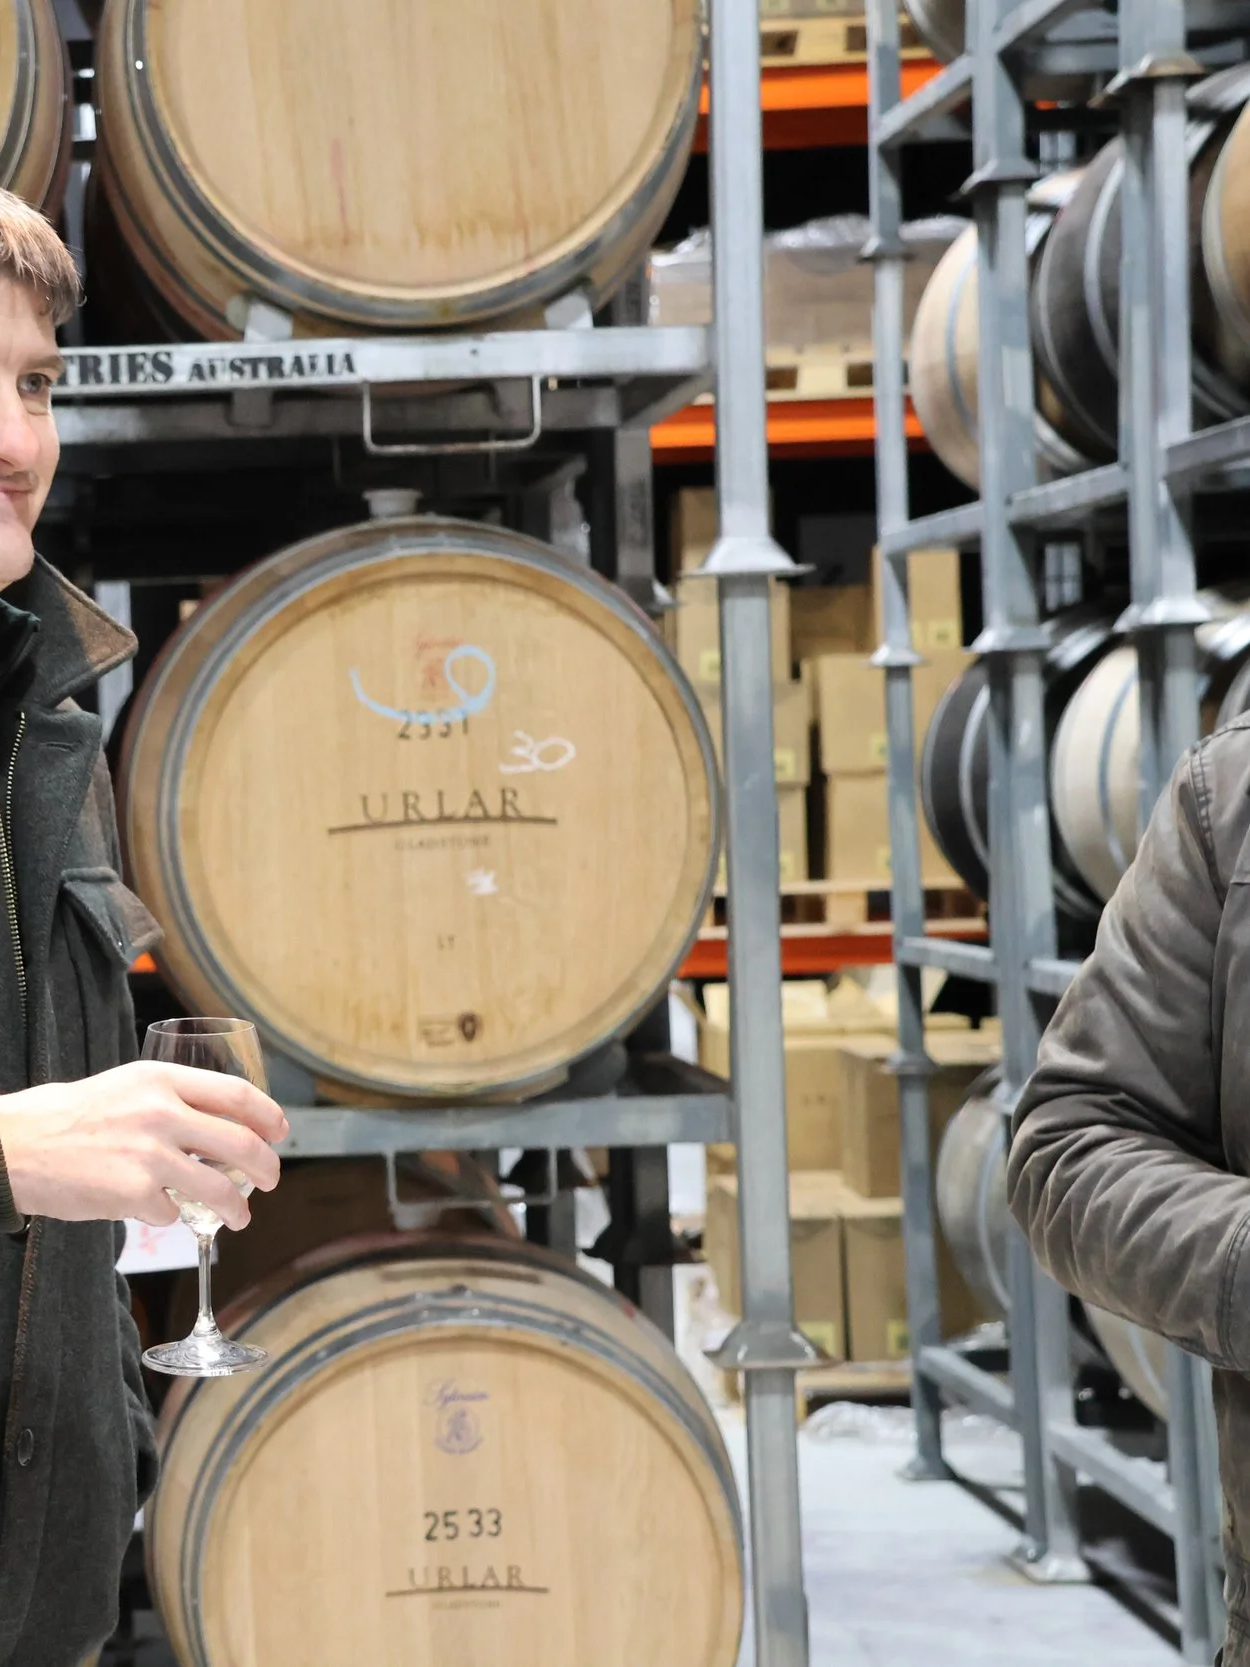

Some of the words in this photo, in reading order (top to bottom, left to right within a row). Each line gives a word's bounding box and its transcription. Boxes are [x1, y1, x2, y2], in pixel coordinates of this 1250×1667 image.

[188, 352, 357, 382] AUSTRALIA
[499, 730, 577, 775] 30
[360, 787, 524, 823] URLAR
[423, 1507, 503, 1542] 2533
[408, 1563, 525, 1590] URLAR
